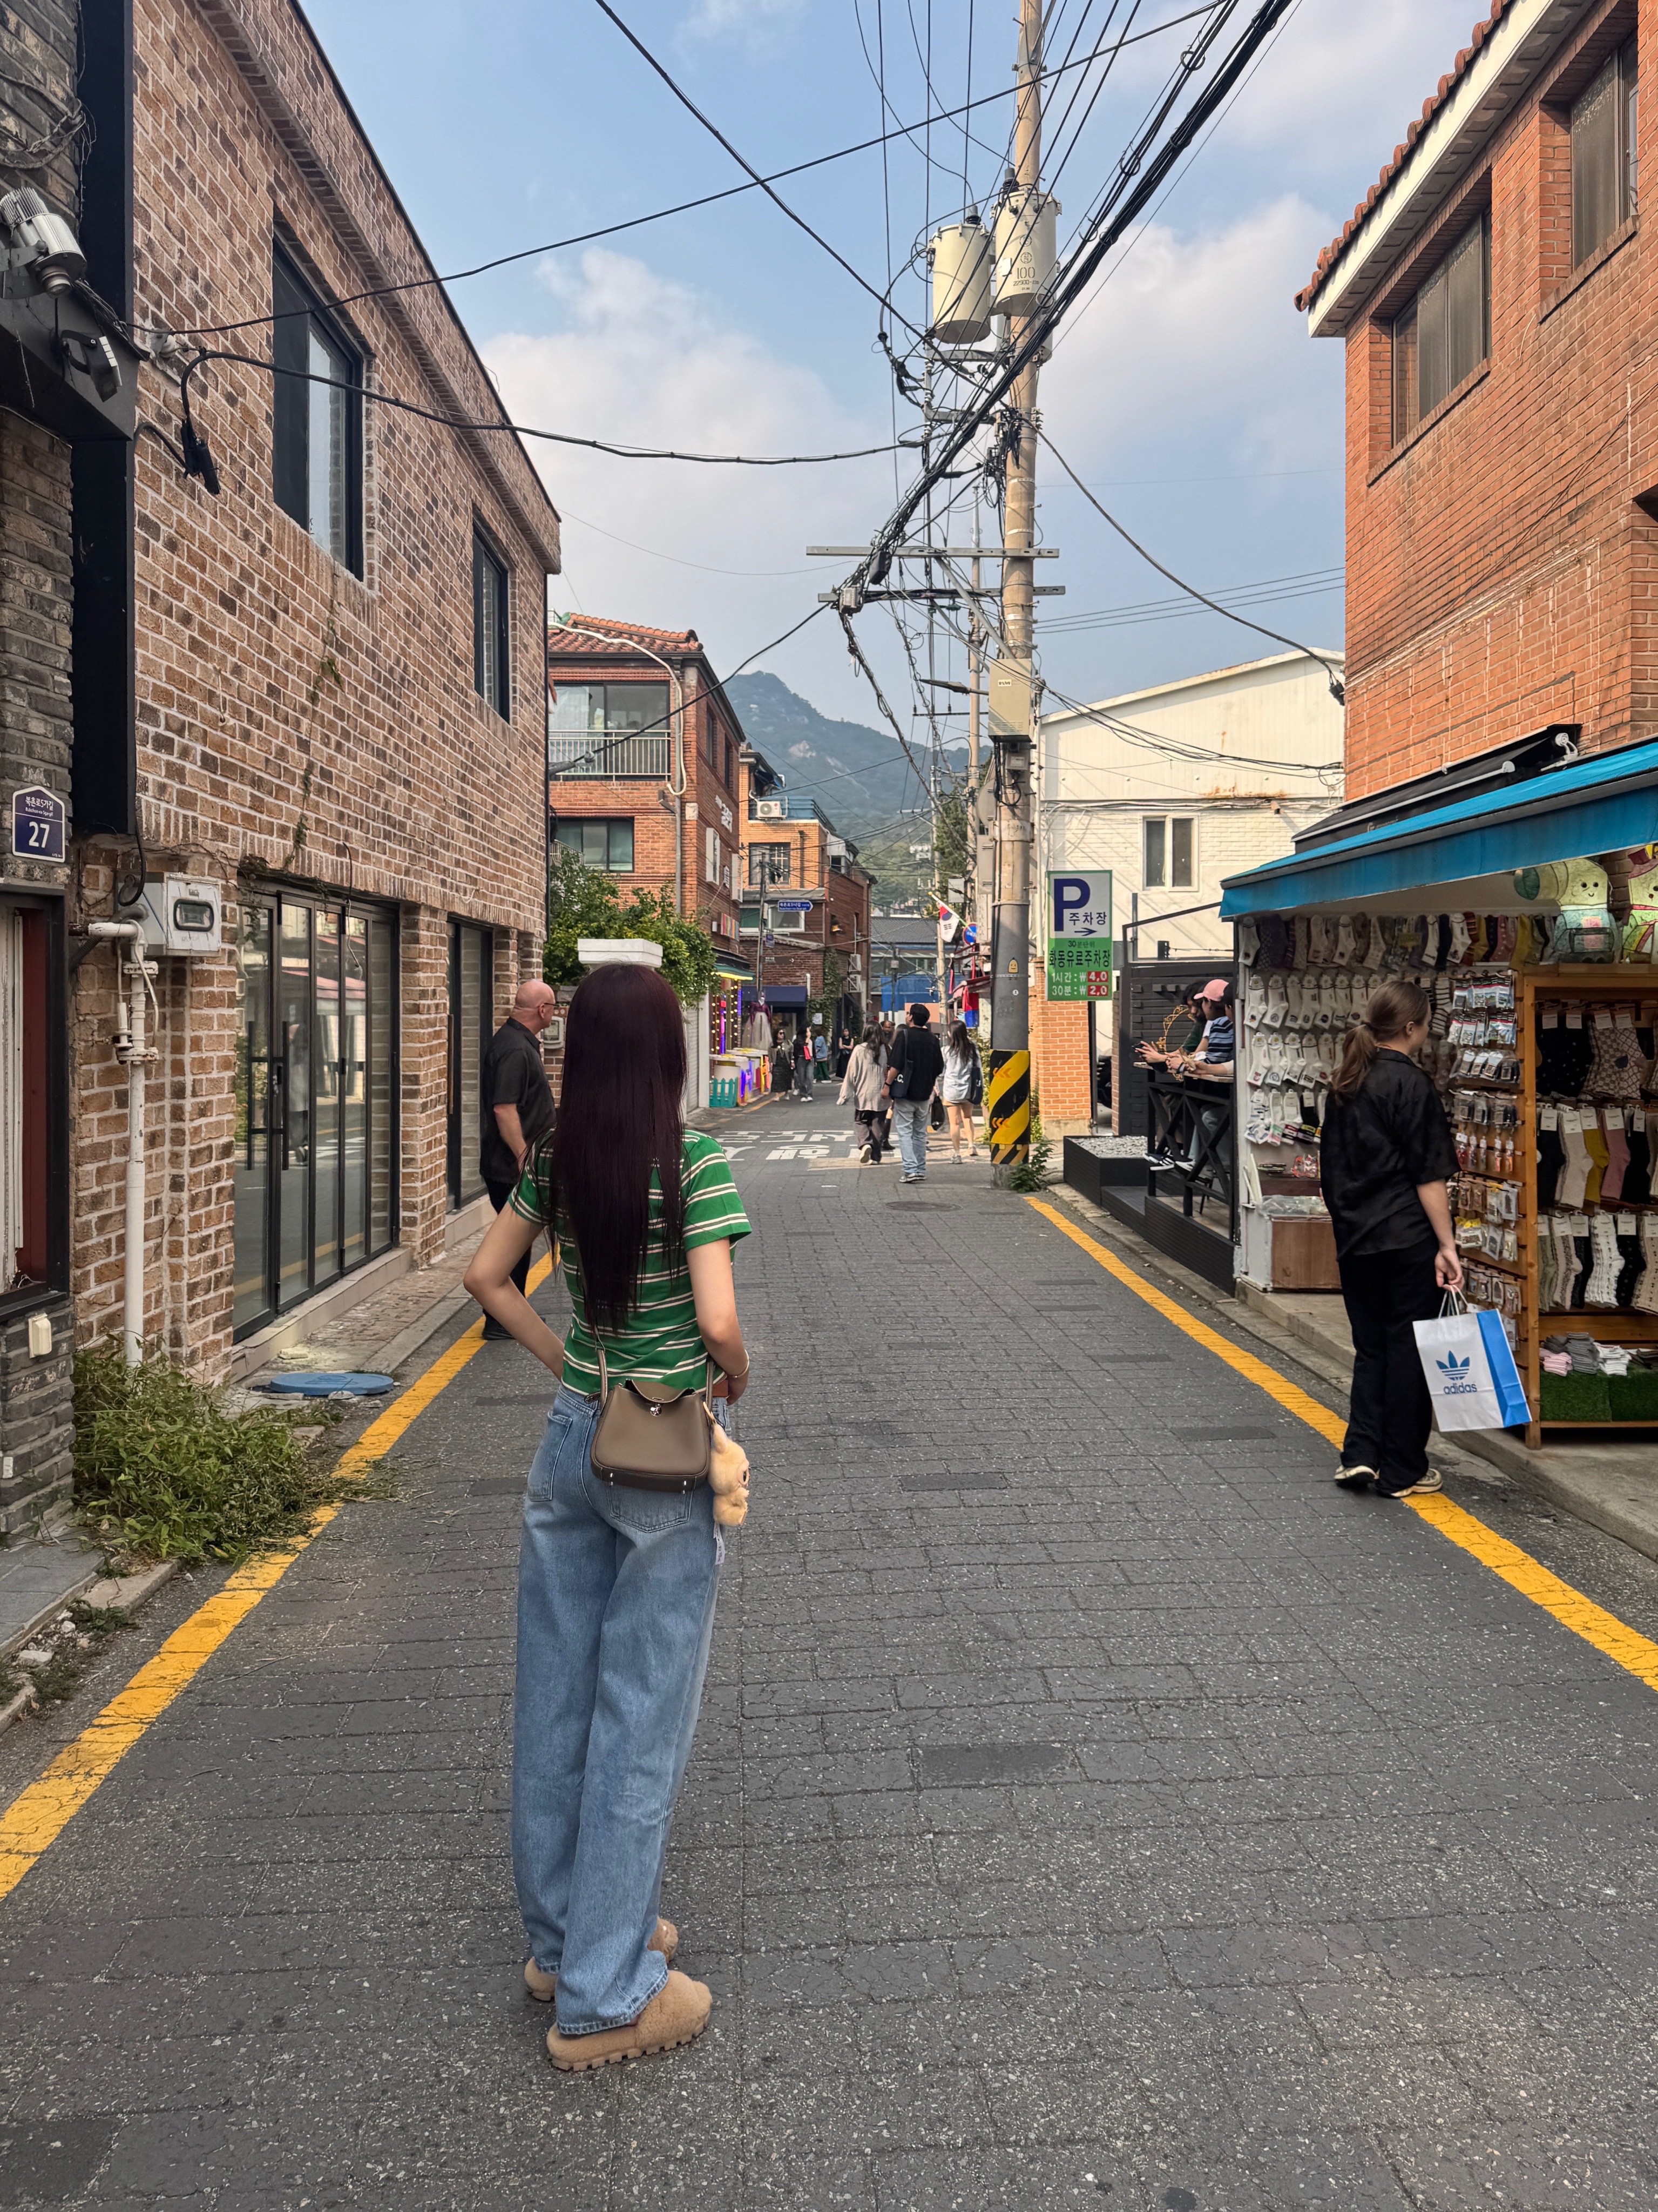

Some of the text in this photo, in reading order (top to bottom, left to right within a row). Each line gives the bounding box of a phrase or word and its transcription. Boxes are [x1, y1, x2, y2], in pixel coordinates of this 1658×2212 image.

[1018, 267, 1035, 279] 100
[25, 796, 53, 811] 북촌로5가길
[29, 821, 50, 848] 27
[1054, 878, 1091, 932] P
[1069, 912, 1107, 926] 주차장
[1049, 949, 1110, 968] 화동유료주차장
[1443, 1382, 1477, 1395] adidas
